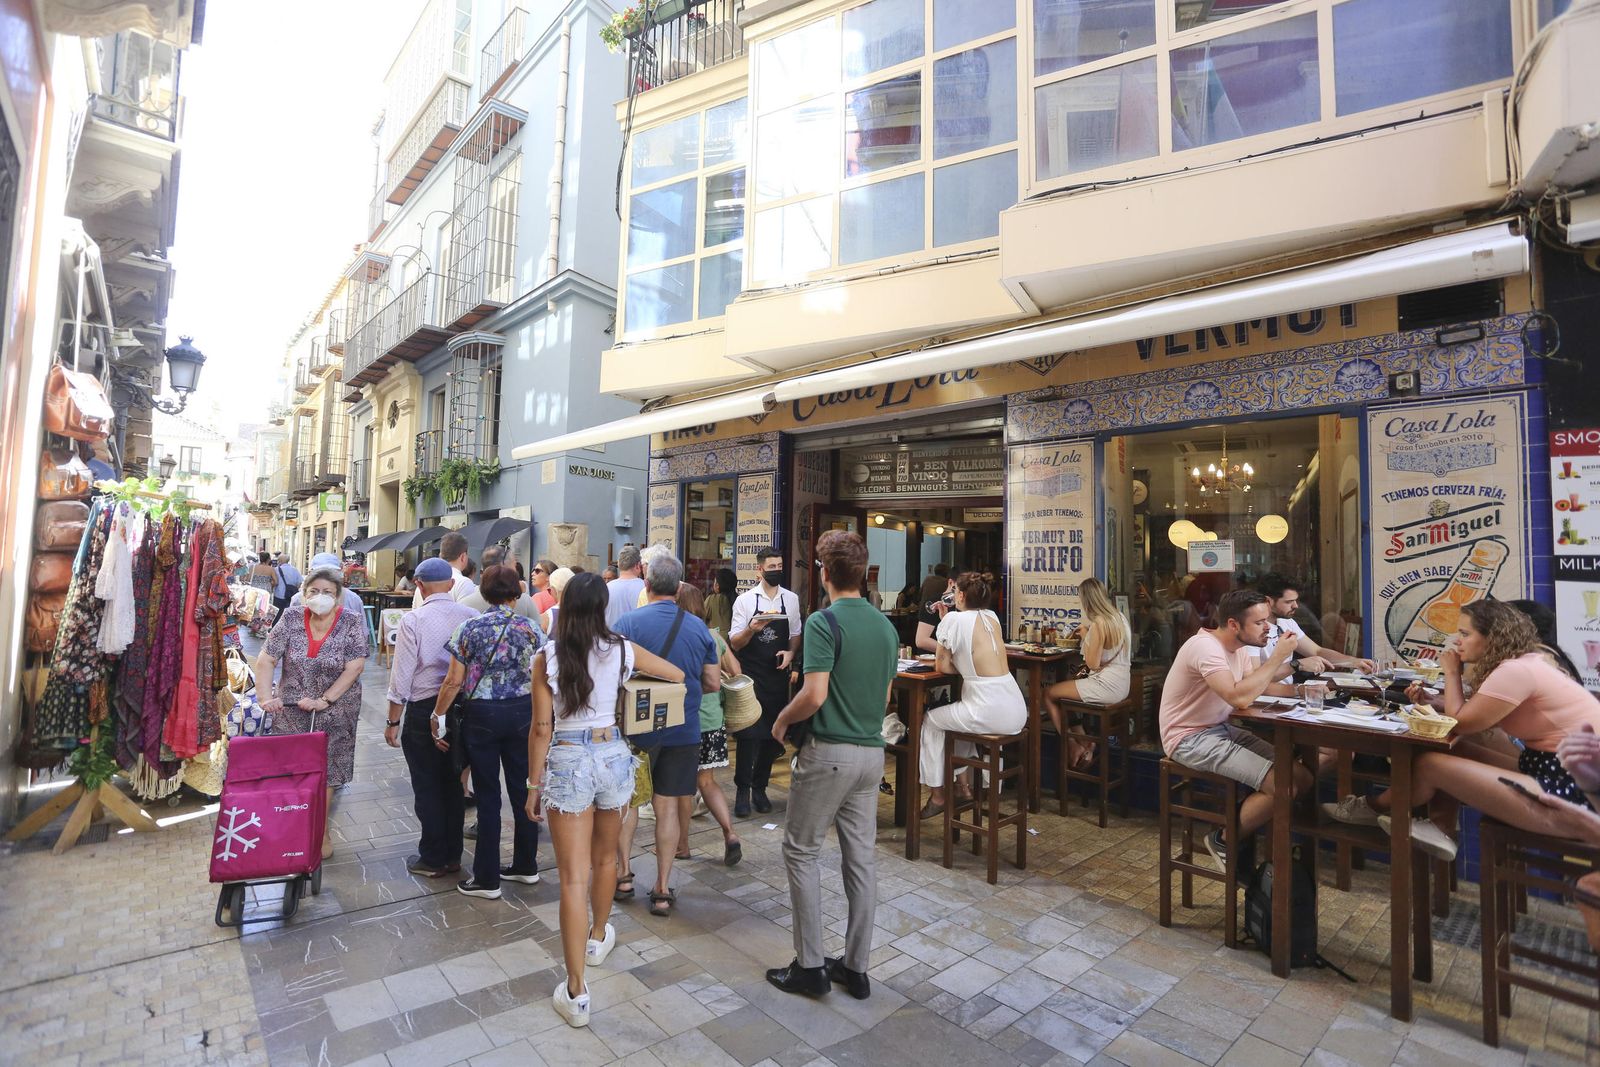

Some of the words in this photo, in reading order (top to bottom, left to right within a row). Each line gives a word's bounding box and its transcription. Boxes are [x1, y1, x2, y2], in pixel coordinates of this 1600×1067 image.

[1385, 416, 1439, 438] Casa
[1441, 410, 1496, 434] Lola
[1461, 433, 1483, 442] 2010
[924, 460, 948, 471] BEN
[1020, 454, 1051, 470] Casa
[1050, 450, 1082, 467] Lola
[569, 464, 589, 476] SAN
[912, 470, 949, 481] VINDO
[740, 481, 755, 494] Casa
[755, 480, 770, 493] Lola
[896, 483, 949, 493] BENVINGUTS
[1381, 486, 1430, 503] TENEMOS
[1431, 485, 1476, 496] CERVEZA
[1037, 509, 1054, 518] BEBER
[1021, 530, 1066, 544] VERMUT
[1069, 530, 1083, 544] DE
[1021, 545, 1084, 573] GRIFO
[1399, 569, 1422, 586] BIEN
[1424, 566, 1453, 578] SABE
[1020, 584, 1039, 595] VINOS
[1040, 584, 1080, 596] MALAGUEÑO
[1020, 607, 1082, 619] VINOS
[273, 803, 309, 812] THERMO
